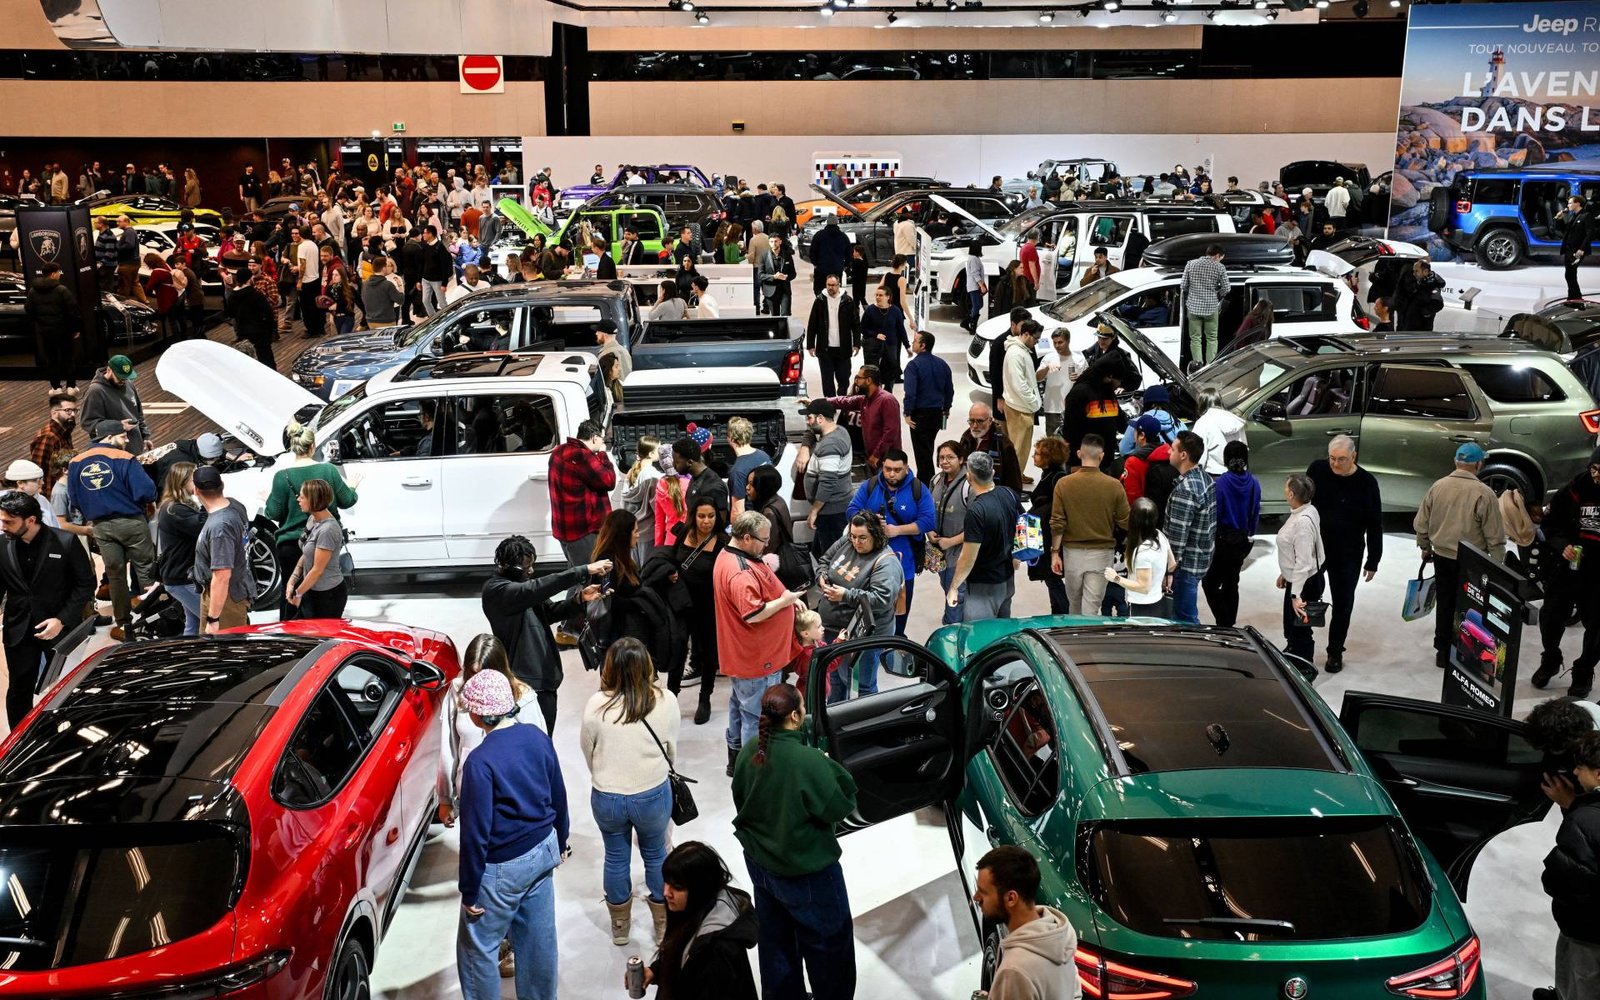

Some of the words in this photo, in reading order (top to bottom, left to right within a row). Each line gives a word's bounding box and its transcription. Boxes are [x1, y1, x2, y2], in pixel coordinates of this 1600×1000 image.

[1522, 14, 1578, 36] Jeep
[1583, 17, 1600, 32] R
[1469, 44, 1506, 54] TOUT
[1507, 43, 1577, 54] NOUVEAU.
[1460, 106, 1566, 132] DANS
[1452, 669, 1470, 688] ALFA
[1470, 683, 1495, 708] ROMEO
